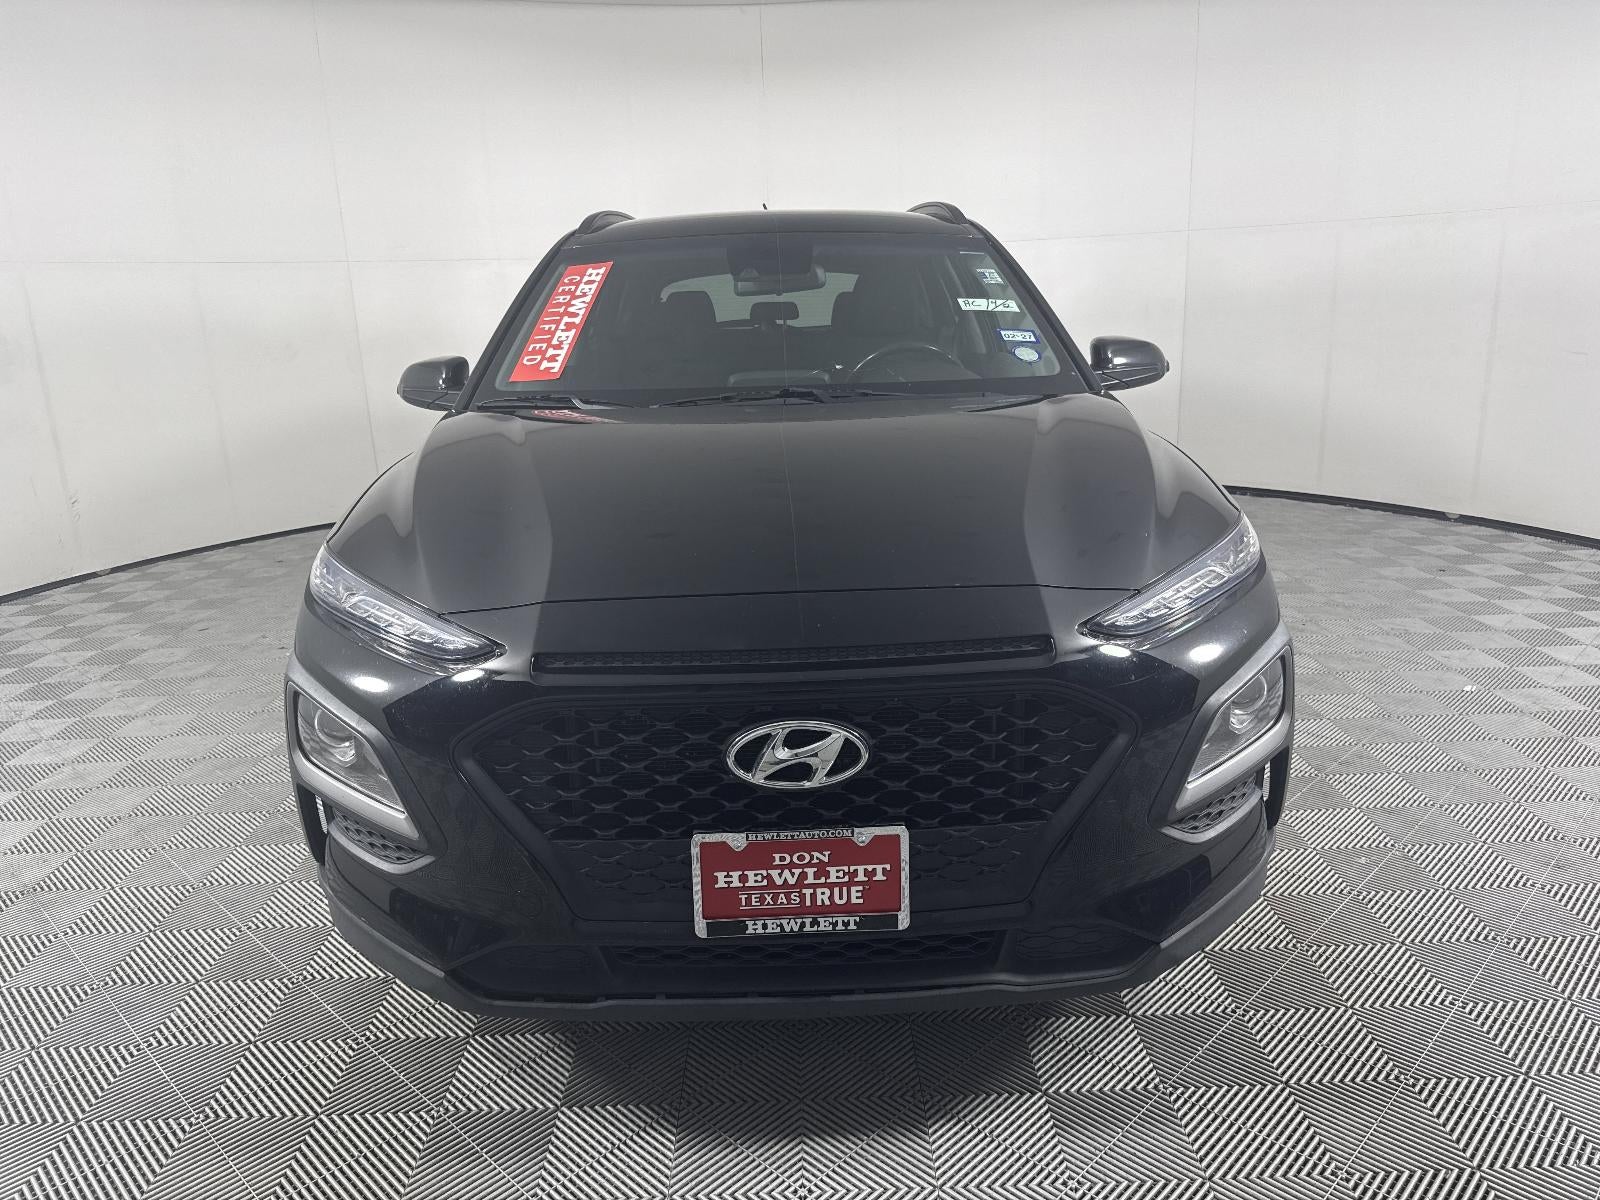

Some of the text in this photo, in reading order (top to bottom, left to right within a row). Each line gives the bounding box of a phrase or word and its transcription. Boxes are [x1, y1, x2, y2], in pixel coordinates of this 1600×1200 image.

[522, 275, 581, 366] CERTIFIED
[540, 267, 606, 373] HEWLETT
[747, 829, 852, 841] HEWLETTAUTO.COM
[772, 851, 831, 866] DON
[713, 864, 891, 889] HEWLETT
[745, 916, 860, 934] HEWLETT
